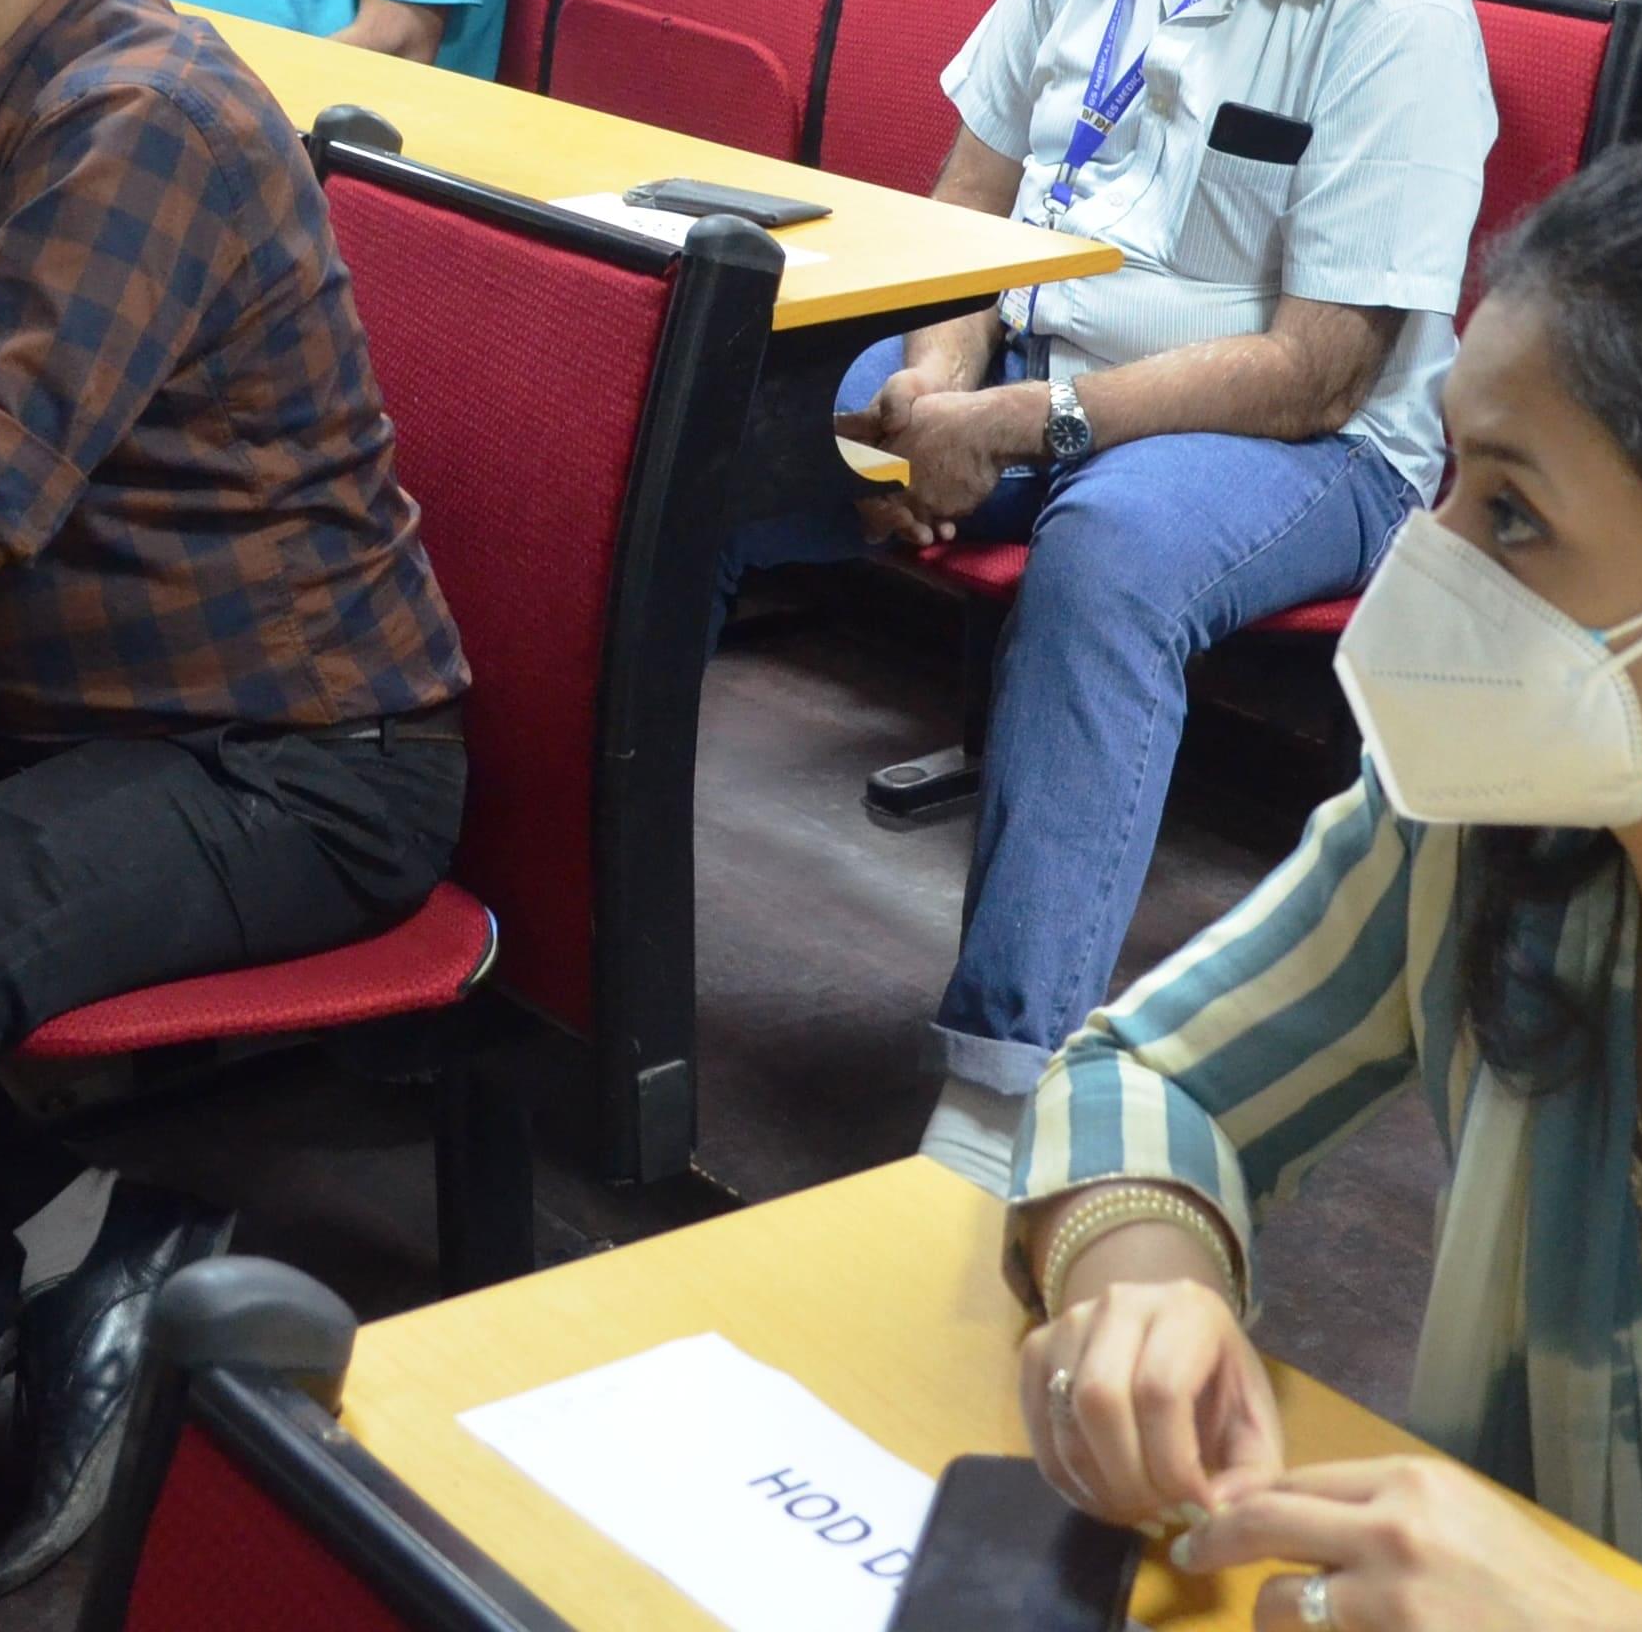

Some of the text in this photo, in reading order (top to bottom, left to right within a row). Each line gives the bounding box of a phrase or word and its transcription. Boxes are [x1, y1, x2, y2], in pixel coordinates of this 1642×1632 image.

[1093, 43, 1111, 90] MEDICAL
[1107, 106, 1119, 119] GS
[747, 1466, 873, 1550] HOD
